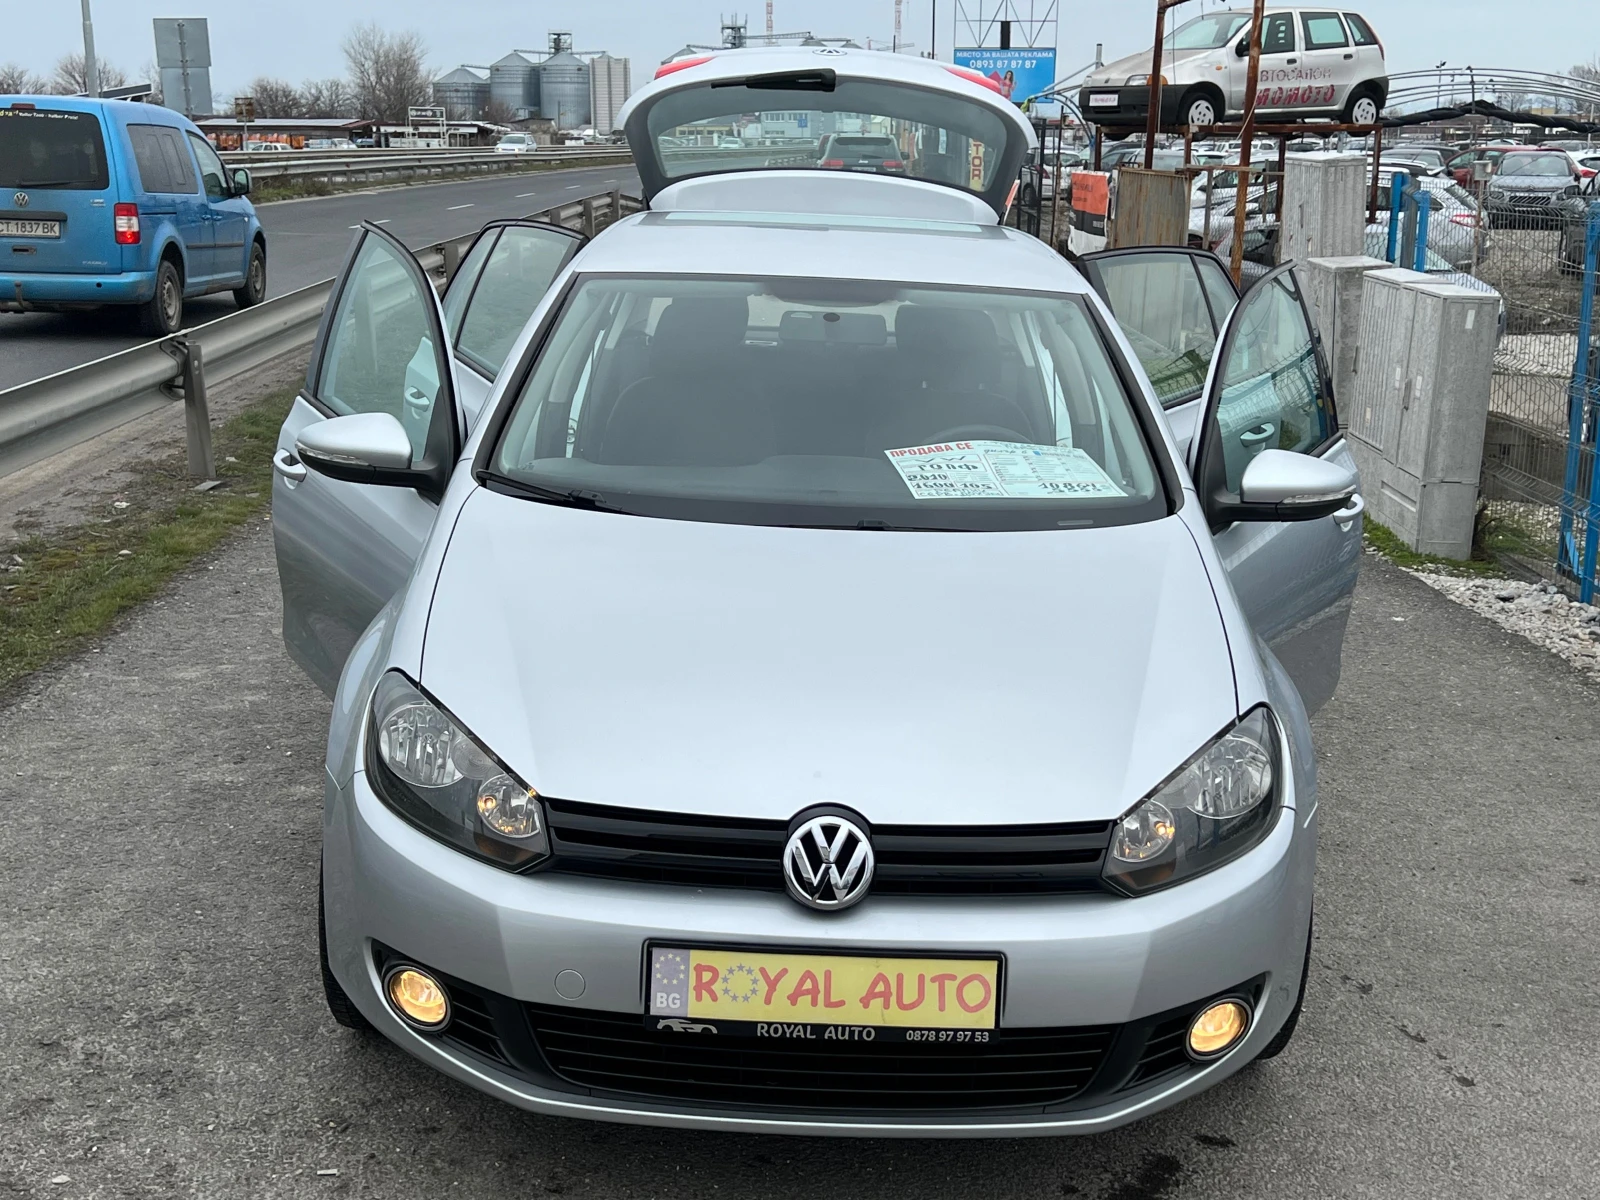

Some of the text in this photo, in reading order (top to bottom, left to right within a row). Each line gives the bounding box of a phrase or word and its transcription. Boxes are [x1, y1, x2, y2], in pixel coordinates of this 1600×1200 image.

[969, 60, 1036, 69] 0893 87 87 87
[15, 222, 40, 234] 1837
[42, 222, 57, 235] BK
[890, 442, 974, 458] ПРОДАВА СЕ
[656, 992, 681, 1009] BG
[859, 972, 992, 1014] AUTO
[757, 1023, 990, 1043] ROYAL AUTO 0878 97 97 53
